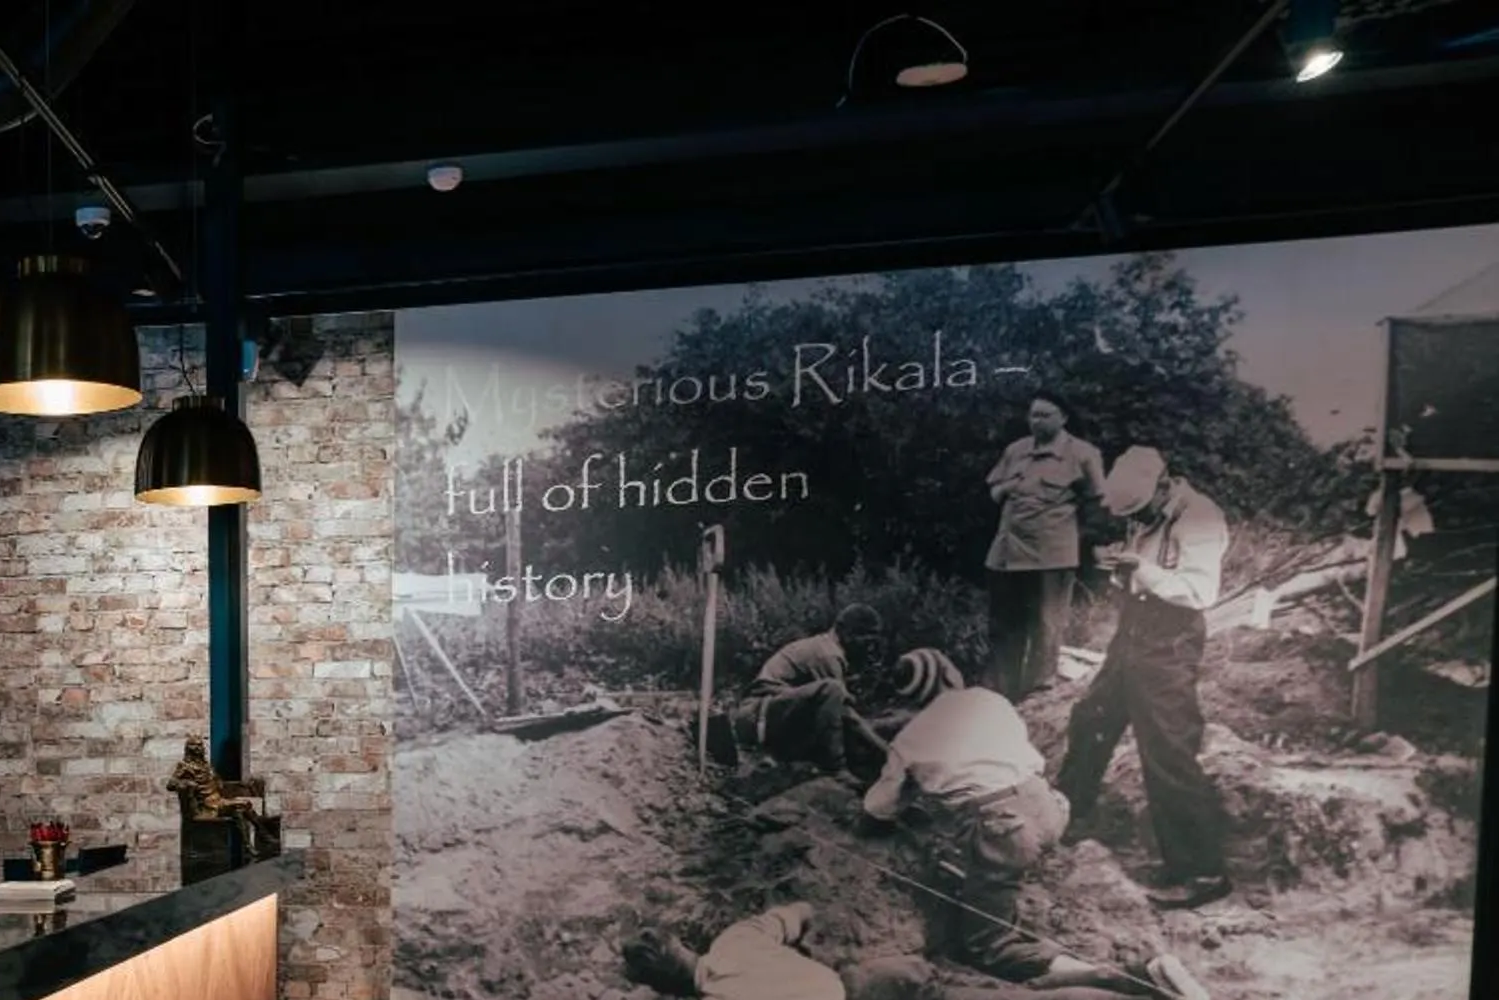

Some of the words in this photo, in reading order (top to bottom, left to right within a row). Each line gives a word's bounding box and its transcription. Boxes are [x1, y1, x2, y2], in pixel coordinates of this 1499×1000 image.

[444, 362, 771, 432] Mysterious
[791, 330, 978, 408] Rikala
[445, 457, 523, 516] full
[542, 452, 603, 512] of
[618, 447, 809, 508] hidden
[447, 550, 632, 621] history
